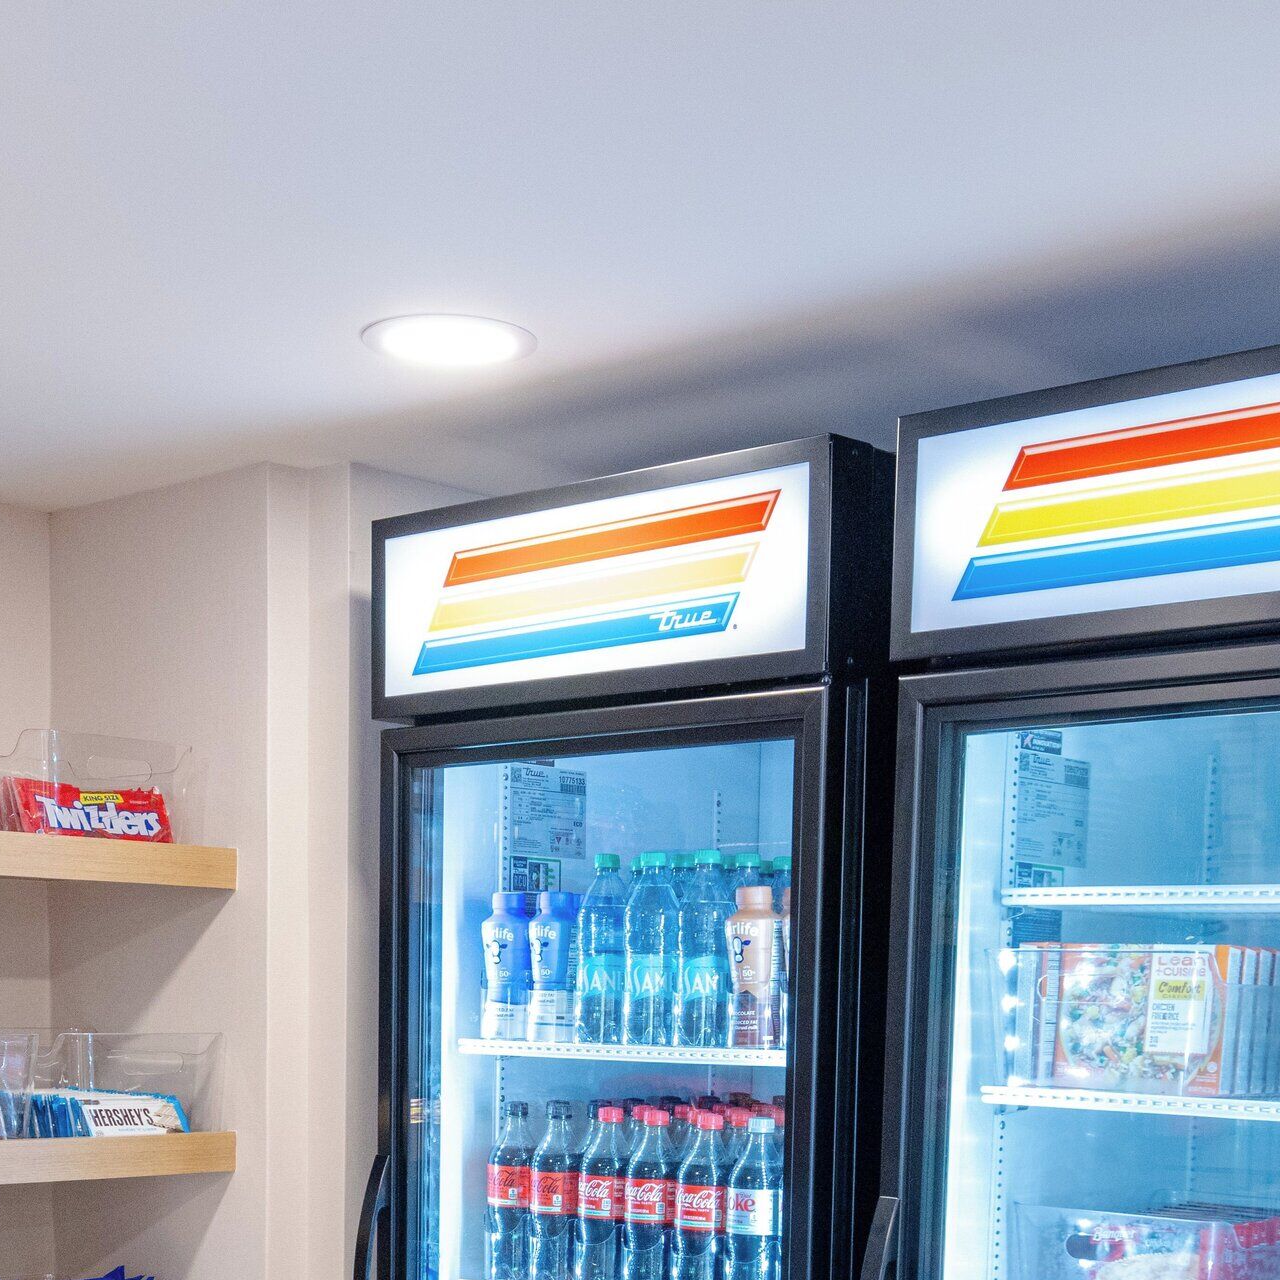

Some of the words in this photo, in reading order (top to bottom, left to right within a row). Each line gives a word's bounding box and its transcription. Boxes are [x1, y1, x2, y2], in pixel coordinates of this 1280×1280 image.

[83, 794, 103, 802] KING
[35, 794, 162, 837] Twizzlers
[89, 1108, 154, 1127] HERSHEY'S
